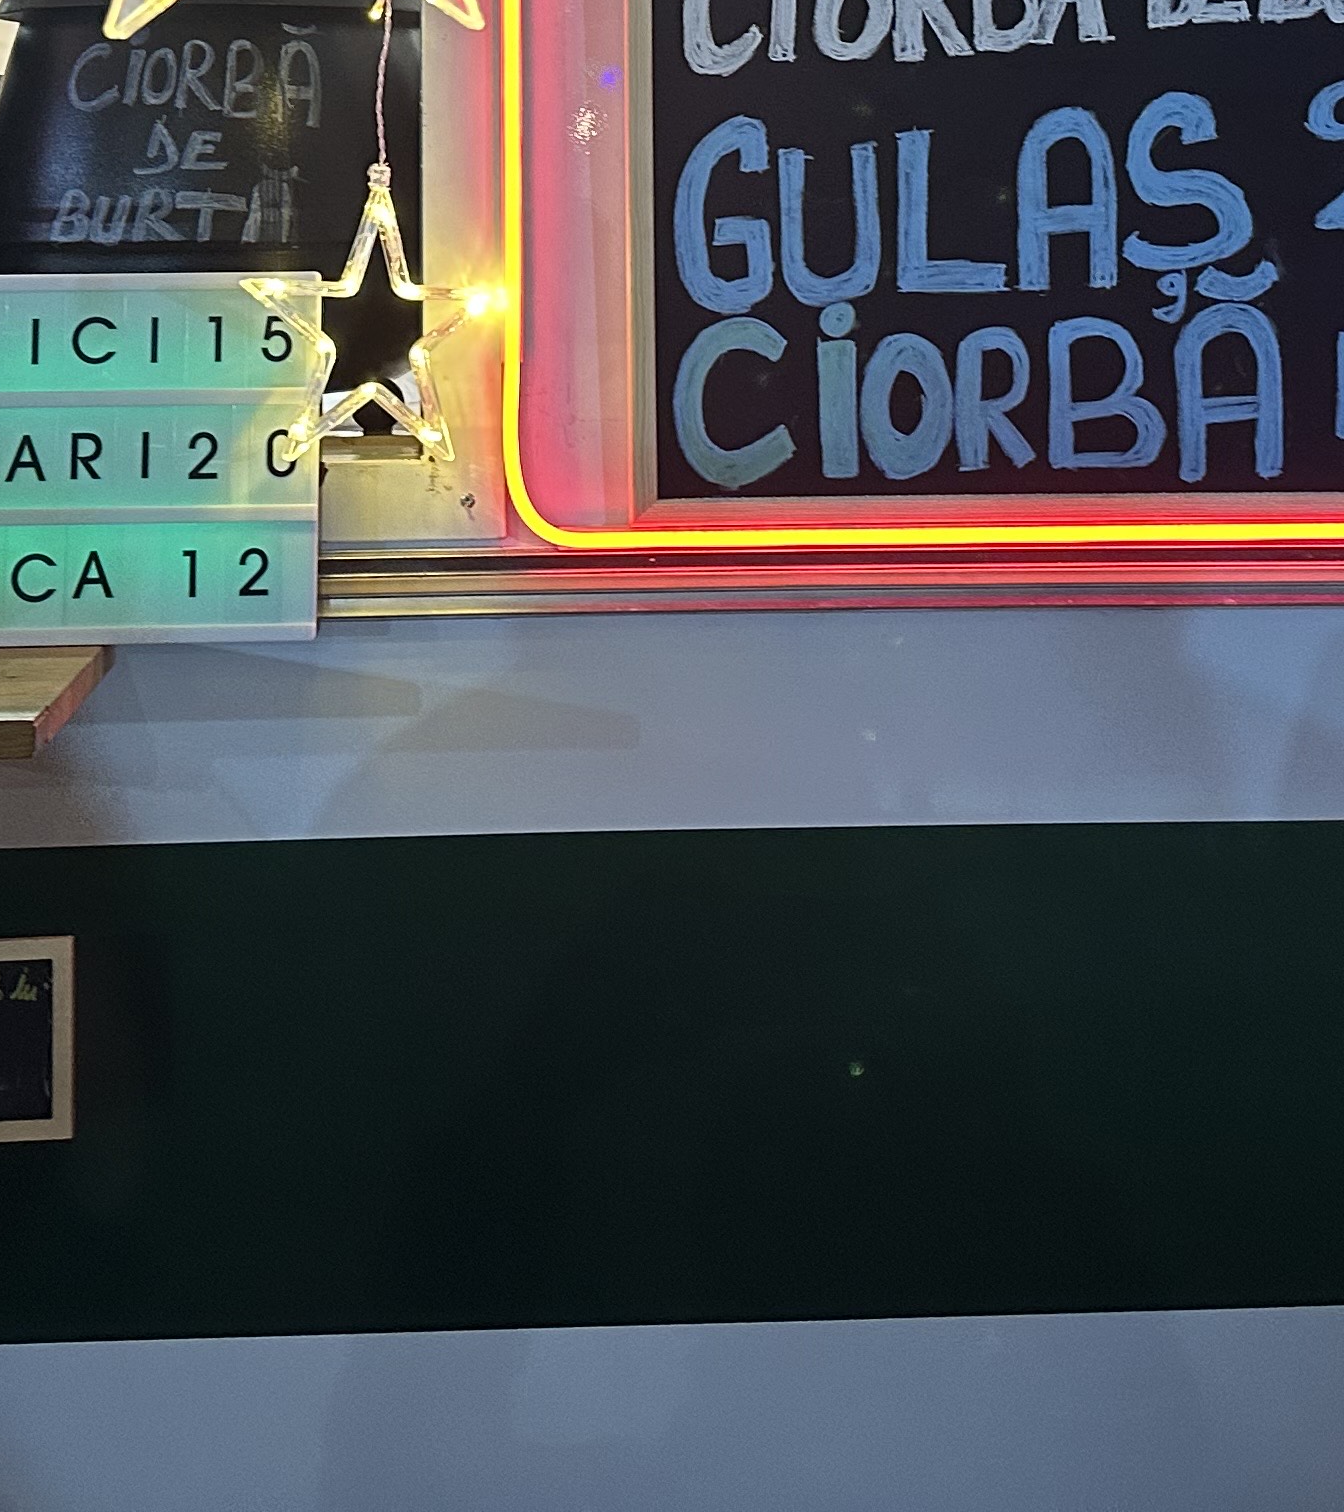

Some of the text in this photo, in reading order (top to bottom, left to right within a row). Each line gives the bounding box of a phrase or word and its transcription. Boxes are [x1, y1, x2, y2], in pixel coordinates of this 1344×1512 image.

[133, 115, 229, 175] DE
[207, 315, 294, 363] 15
[180, 547, 270, 598] 12
